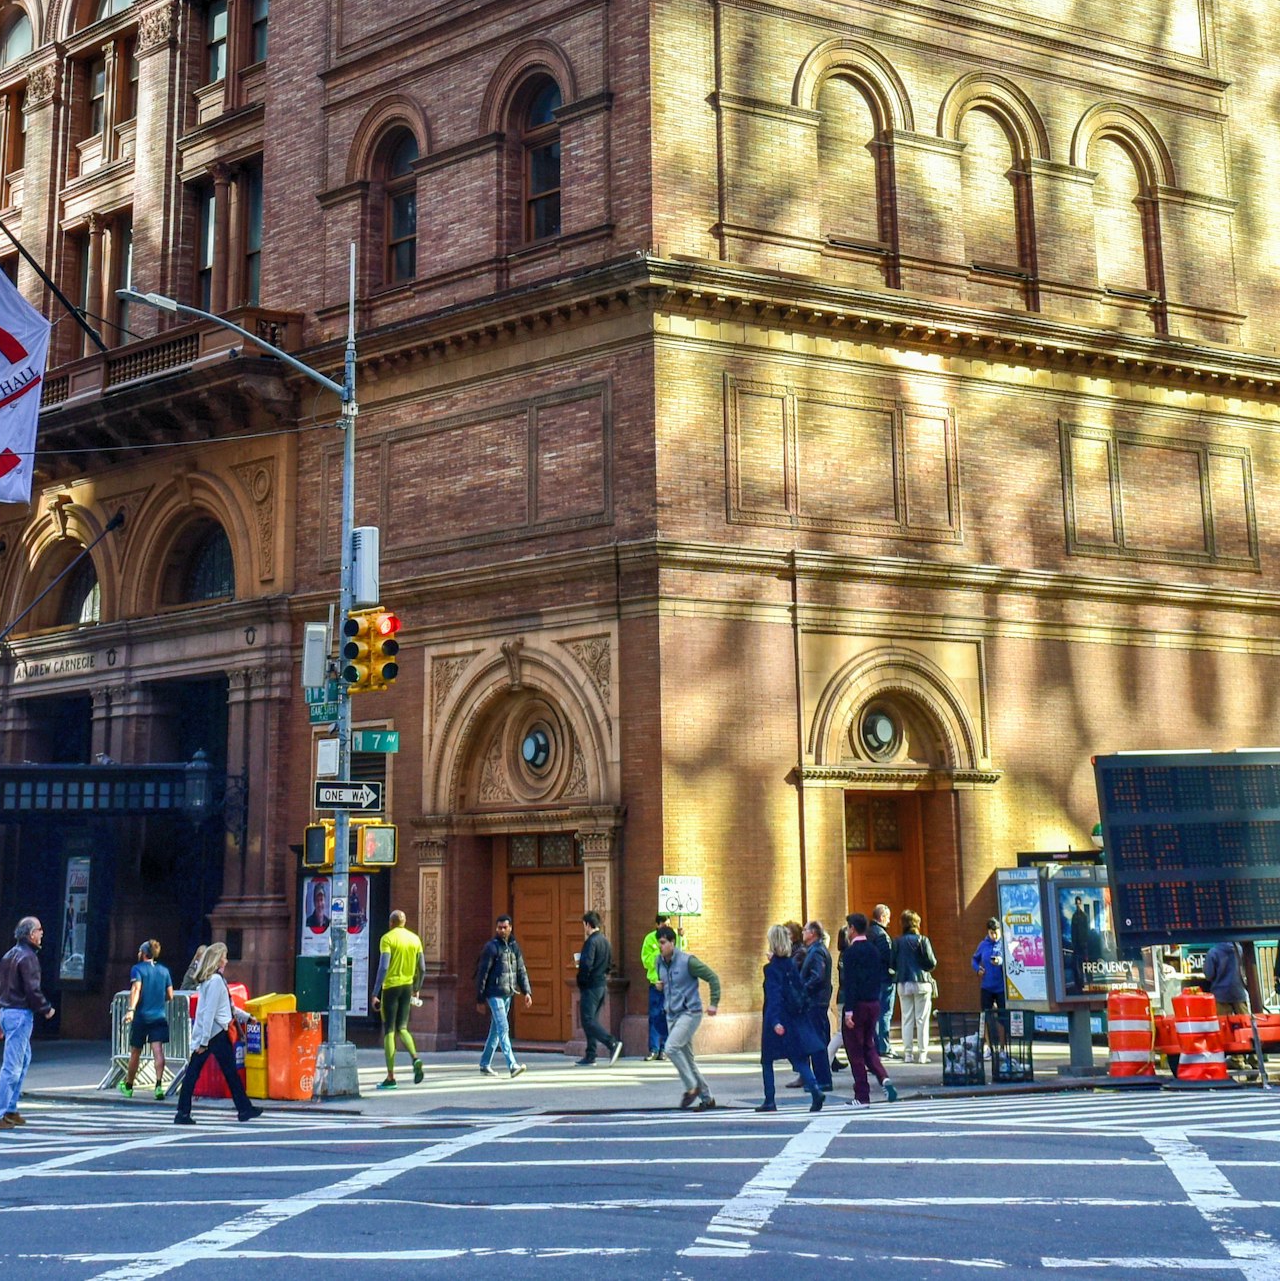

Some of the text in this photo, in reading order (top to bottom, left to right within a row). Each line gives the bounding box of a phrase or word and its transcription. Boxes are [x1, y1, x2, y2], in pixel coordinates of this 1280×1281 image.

[15, 656, 95, 679] ANDREW CARNEGIE
[372, 734, 395, 749] 7 AV
[325, 790, 371, 801] ONE WAY
[1121, 823, 1183, 871] 42
[1008, 871, 1028, 879] TITAN
[1009, 915, 1029, 923] SWITCH
[1082, 961, 1133, 974] FREQUENCY
